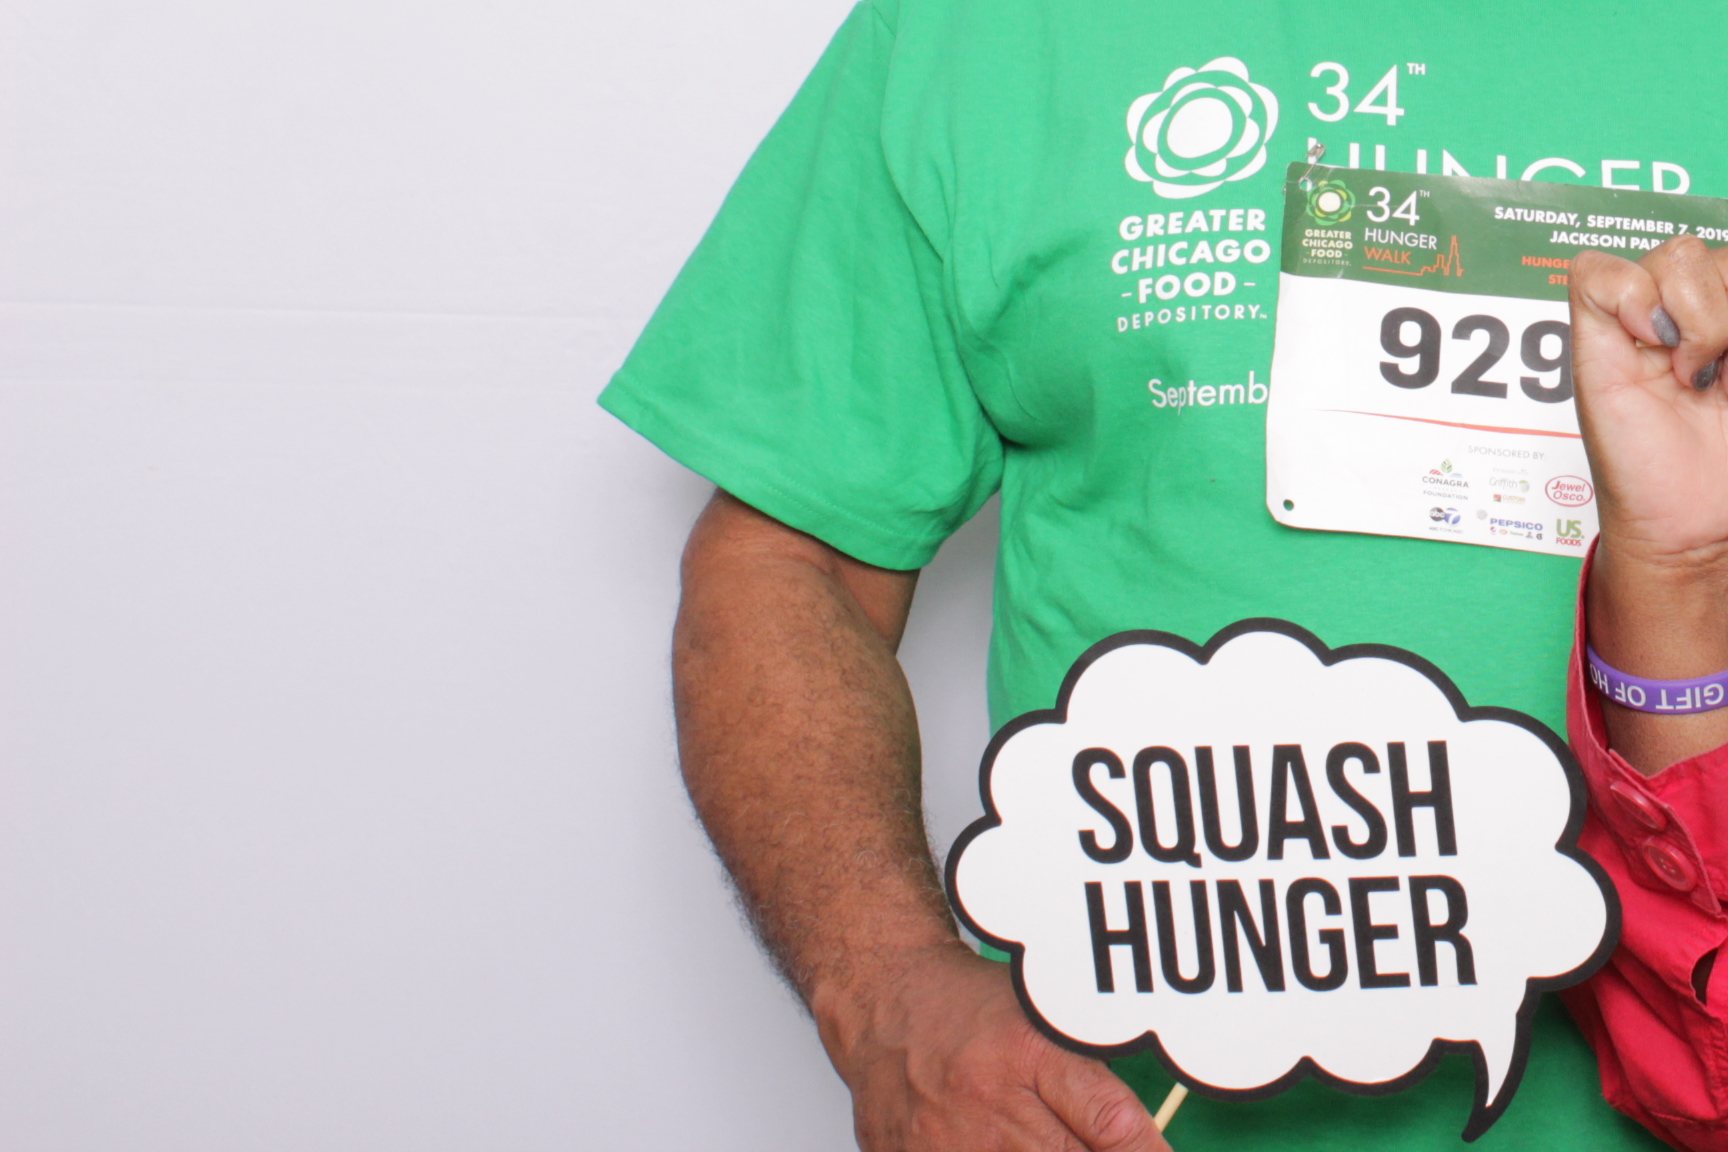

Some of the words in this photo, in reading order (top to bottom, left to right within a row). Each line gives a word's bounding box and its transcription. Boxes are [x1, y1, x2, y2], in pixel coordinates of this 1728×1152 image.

[1119, 208, 1266, 240] GREATER
[1494, 207, 1581, 228] SATURDAY,
[1587, 215, 1674, 235] SEPTEMBER
[1302, 238, 1353, 249] CHICAGO
[1305, 229, 1352, 240] GREATER
[1364, 228, 1437, 250] HUNGER
[1550, 231, 1626, 248] JACKSON
[1630, 237, 1666, 250] PAR
[1111, 239, 1271, 275] CHICAGO
[1364, 246, 1413, 265] WALK
[1521, 255, 1571, 269] HUNGE
[1548, 273, 1568, 285] STE
[1379, 306, 1574, 403] 929
[1148, 371, 1268, 415] Septemb
[1468, 445, 1530, 459] SPONSORED
[1422, 476, 1469, 488] CONAGRA
[1552, 481, 1585, 492] Jewel
[1423, 490, 1468, 500] FOUNDATION
[1490, 518, 1543, 531] PEPSICO
[1556, 537, 1582, 546] FOODS
[1614, 682, 1647, 707] OF
[1656, 683, 1725, 710] GIFT
[1072, 740, 1458, 868] SQUASH
[1084, 875, 1478, 994] HUNGER
